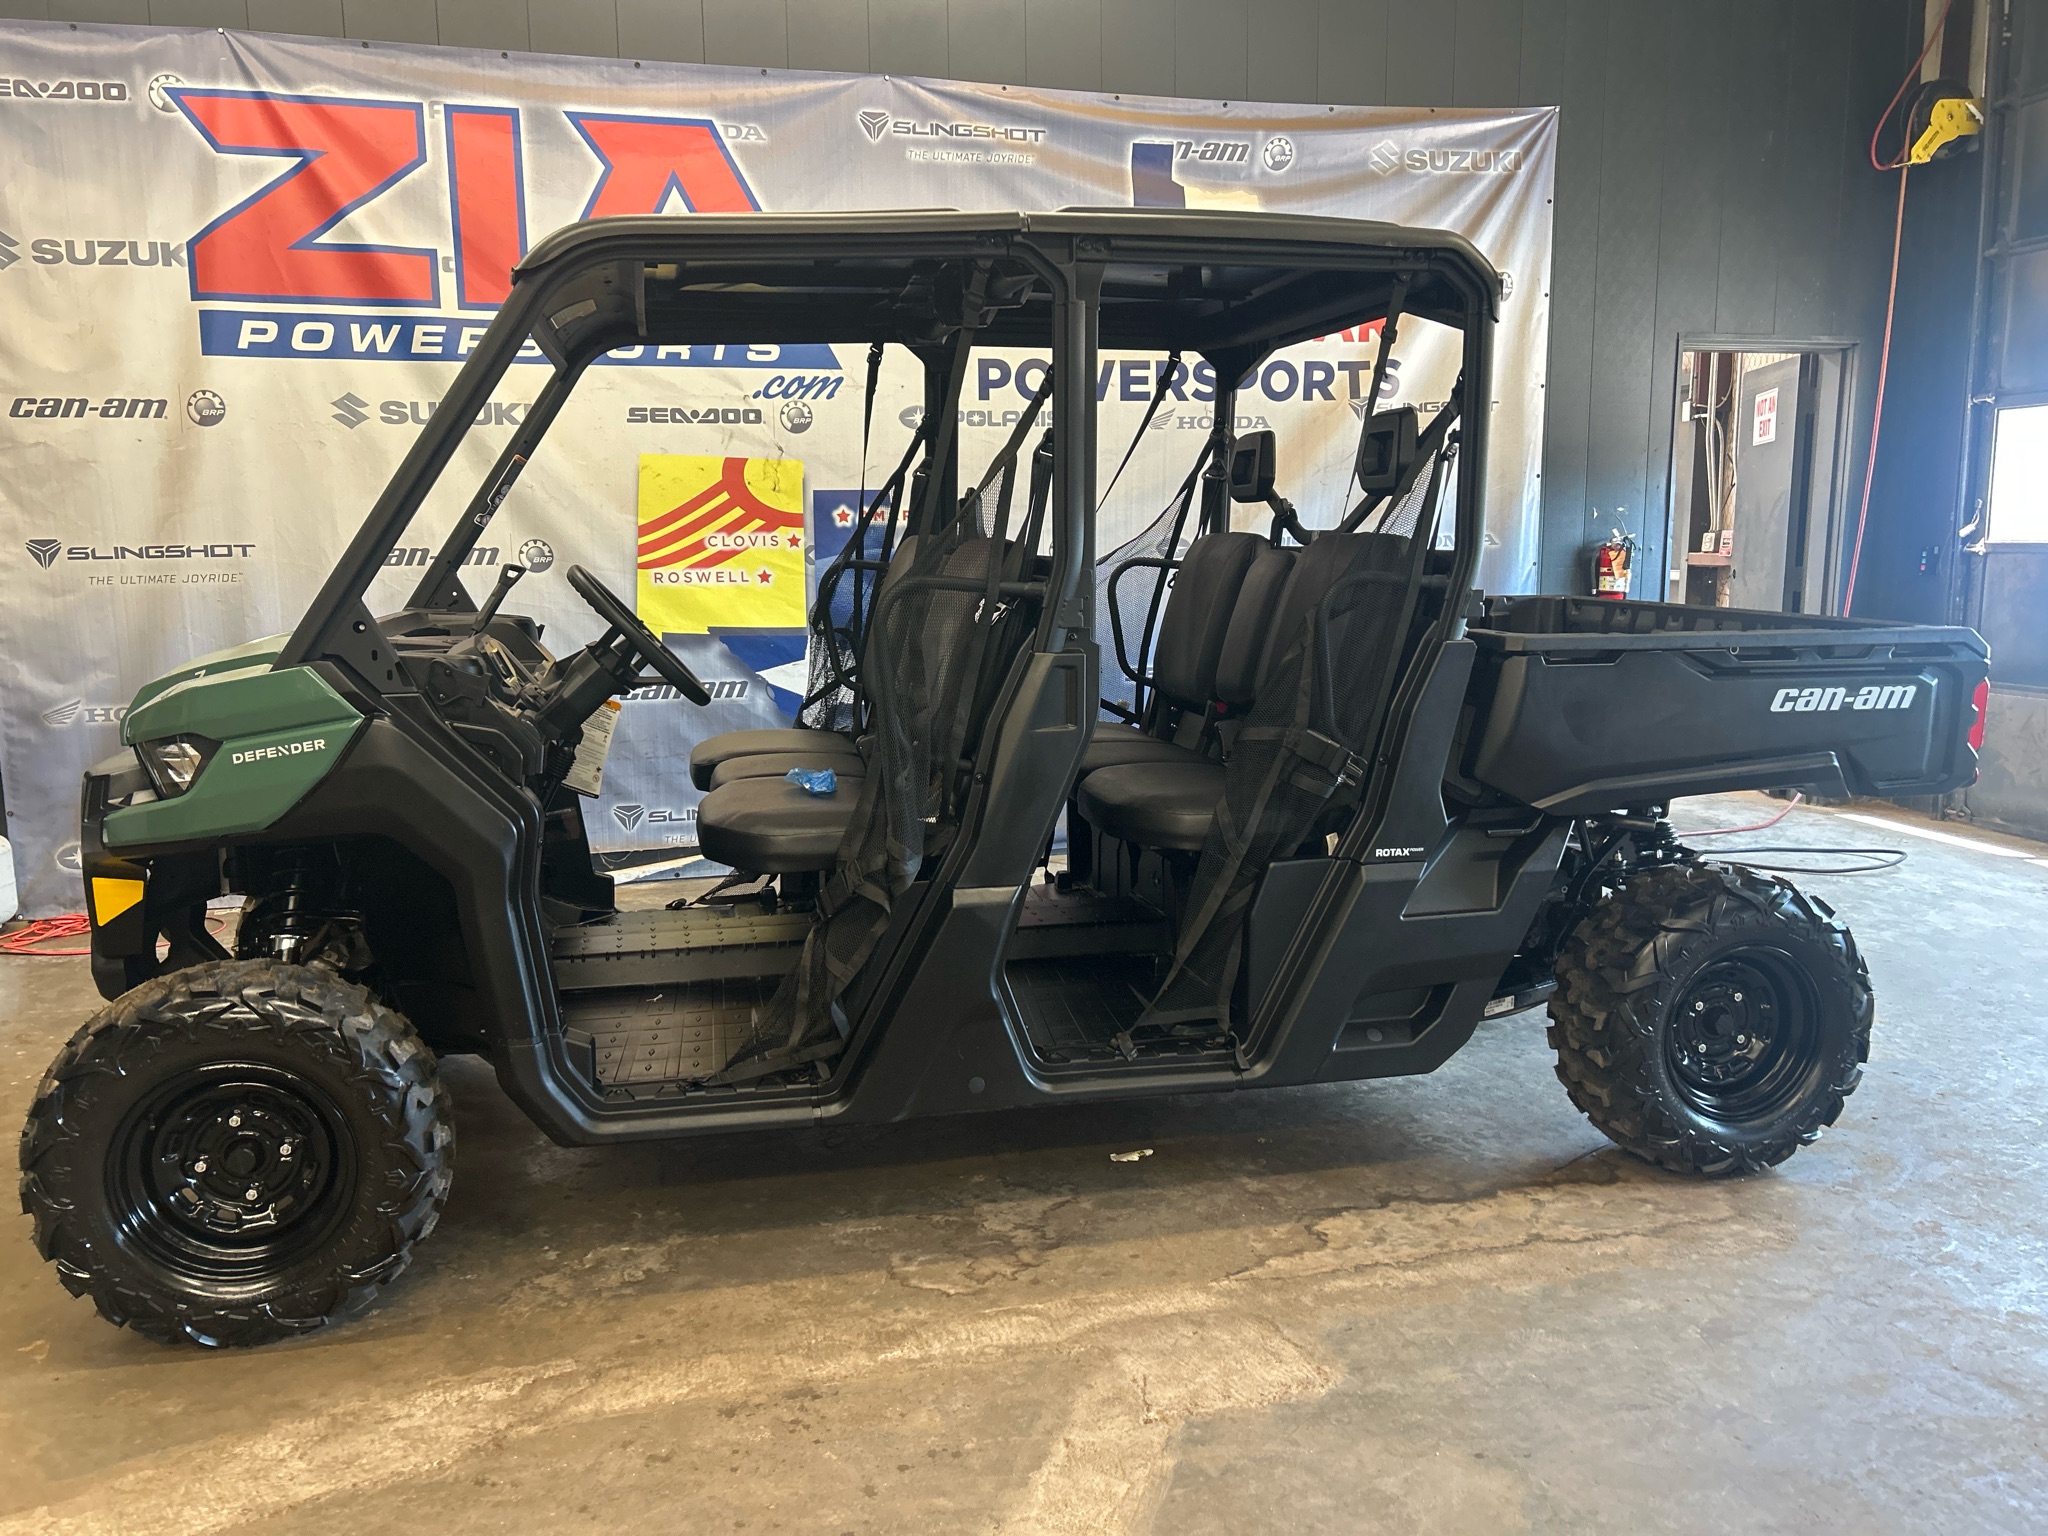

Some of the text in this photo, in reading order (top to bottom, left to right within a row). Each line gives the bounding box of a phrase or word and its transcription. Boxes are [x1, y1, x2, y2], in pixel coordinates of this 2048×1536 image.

[892, 120, 1047, 143] SLINGSHOT
[907, 149, 928, 160] THE
[932, 151, 982, 163] ULTIMATE
[1405, 148, 1523, 173] SUZUKI
[31, 238, 187, 268] SUZUK
[752, 374, 845, 400] .com
[9, 397, 168, 419] can-am
[201, 408, 225, 416] BRP
[1756, 395, 1777, 418] NOT AN
[793, 416, 813, 425] BRP
[1176, 415, 1272, 429] HODA
[1758, 417, 1772, 438] EXIT
[707, 534, 780, 547] CLOVIS
[67, 543, 257, 561] SLINGSHOT
[532, 556, 553, 564] BRP
[88, 575, 114, 586] THE
[120, 573, 177, 585] ULTIMATE
[653, 570, 750, 583] ROSWELL
[1769, 684, 1918, 713] can-am
[231, 738, 327, 766] DEFENDER
[665, 835, 685, 844] THE
[1375, 847, 1410, 857] ROTAX
